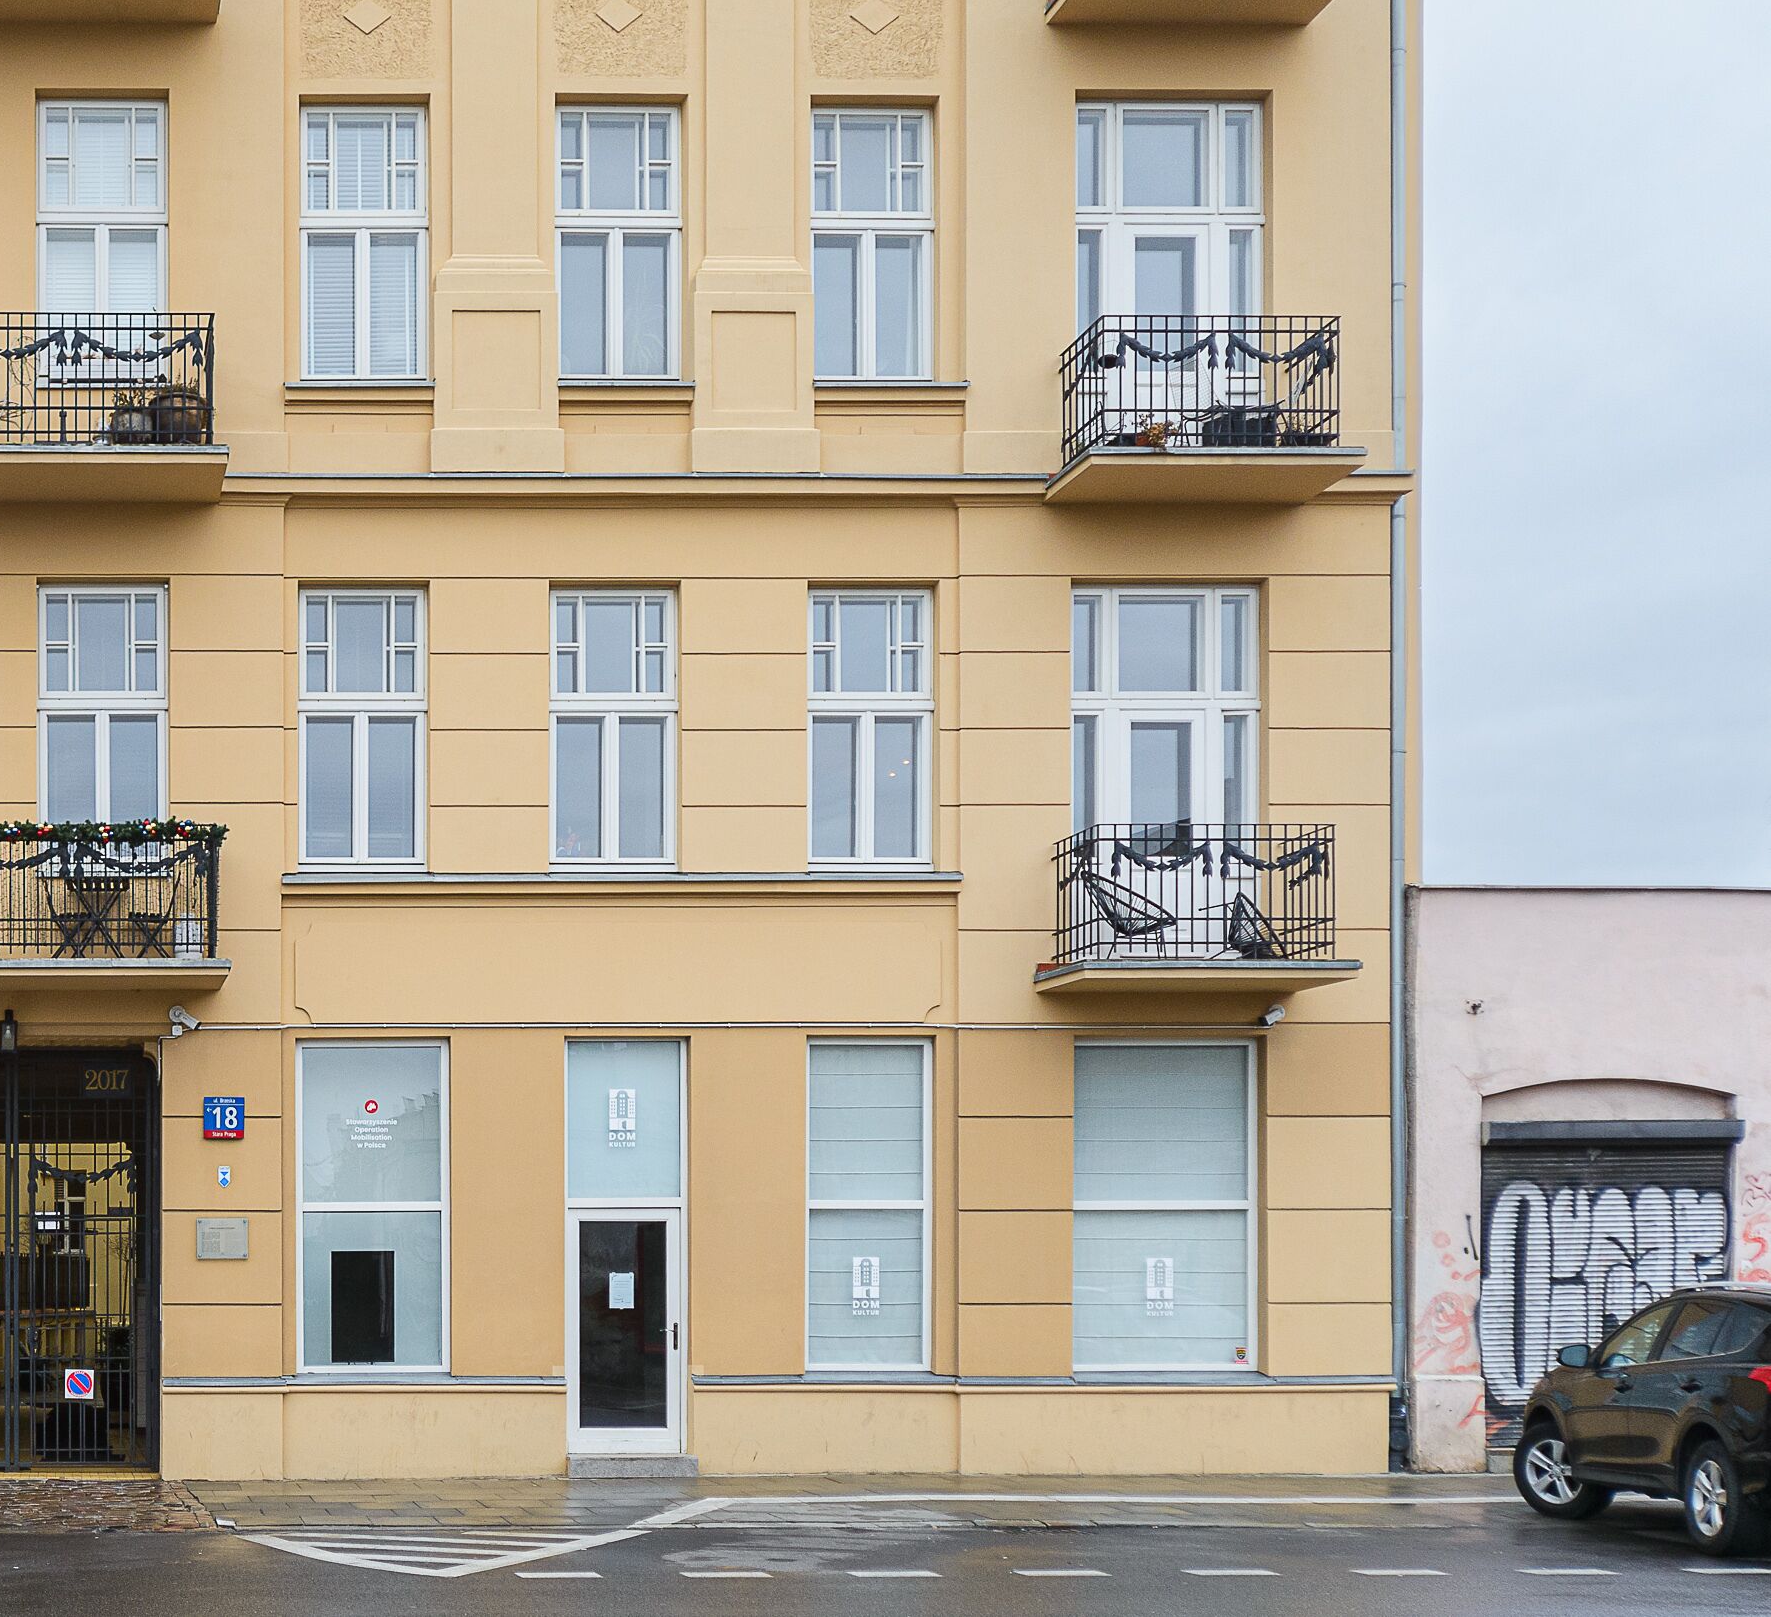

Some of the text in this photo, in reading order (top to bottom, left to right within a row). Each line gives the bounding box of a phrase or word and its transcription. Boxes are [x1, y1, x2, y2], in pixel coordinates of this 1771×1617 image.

[85, 1069, 129, 1090] 2017
[212, 1106, 238, 1129] 18
[346, 1118, 398, 1127] Stowarzyszenie
[354, 1126, 389, 1134] Operation
[350, 1133, 393, 1141] Mobilisation
[609, 1132, 636, 1141] DOM
[852, 1300, 880, 1309] DOM
[1147, 1301, 1174, 1310] DOM
